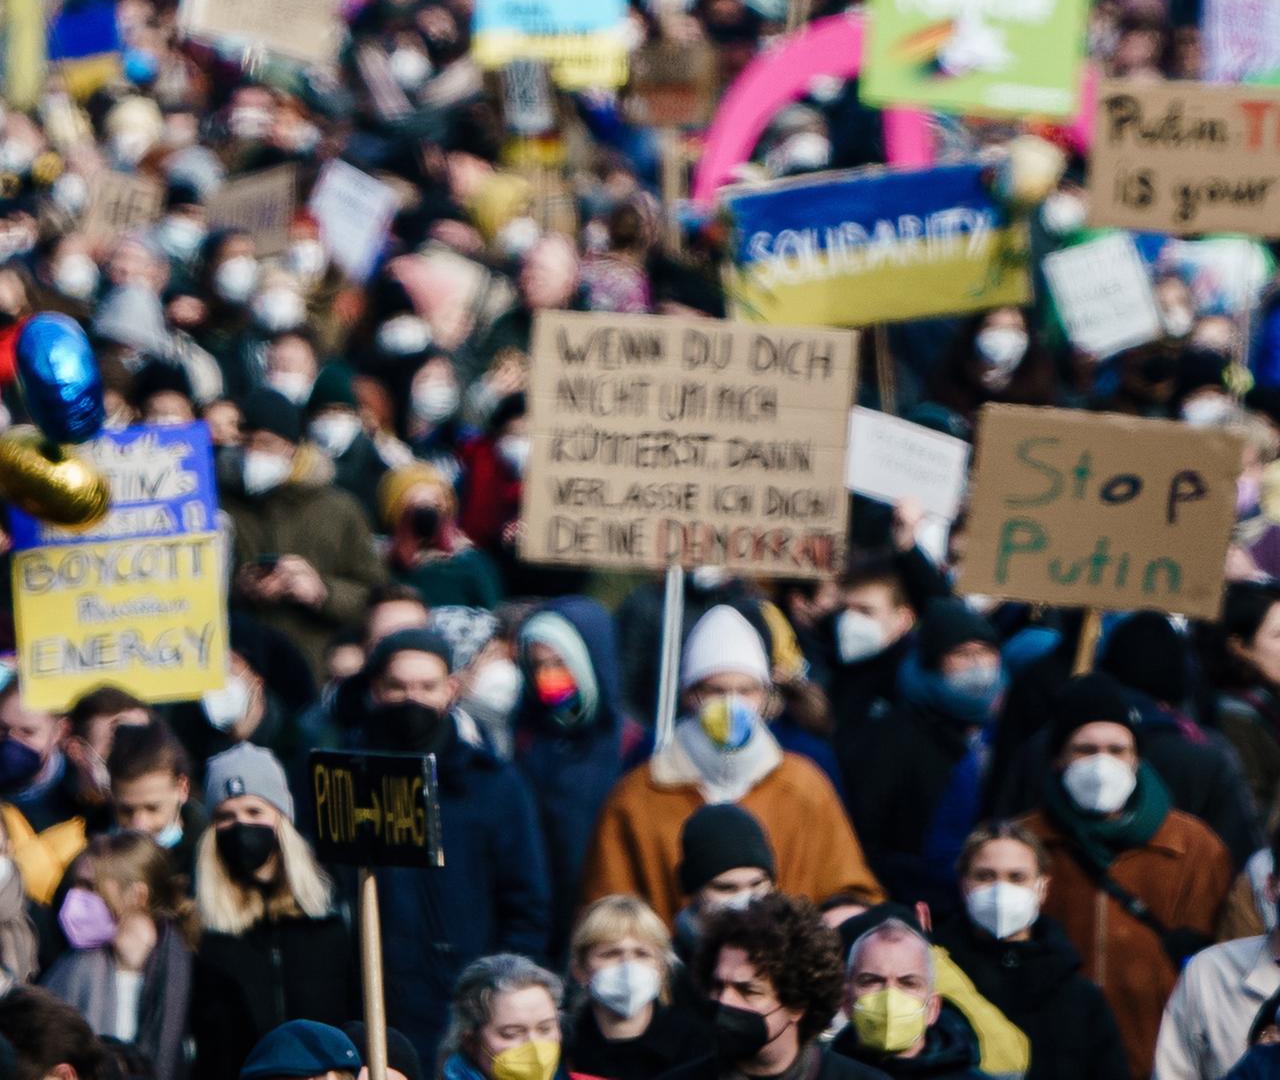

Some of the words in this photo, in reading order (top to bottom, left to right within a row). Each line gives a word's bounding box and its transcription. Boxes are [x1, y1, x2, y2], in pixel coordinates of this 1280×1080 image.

[1104, 93, 1228, 148] Putin
[1176, 176, 1276, 222] your
[748, 206, 992, 290] SOLIDARITY
[556, 324, 666, 370] WENN
[680, 328, 734, 370] DU
[750, 333, 834, 380] DICH
[556, 375, 650, 417] NICHT
[658, 381, 706, 422] UM
[726, 437, 812, 471] DANN
[1003, 436, 1209, 523] Stop
[554, 478, 702, 512] VERLASSE
[710, 483, 756, 517] ICH
[548, 516, 646, 558] DEINE
[995, 517, 1182, 594] Putin
[22, 542, 204, 594] BOYCOTT
[30, 621, 216, 680] ENERGY
